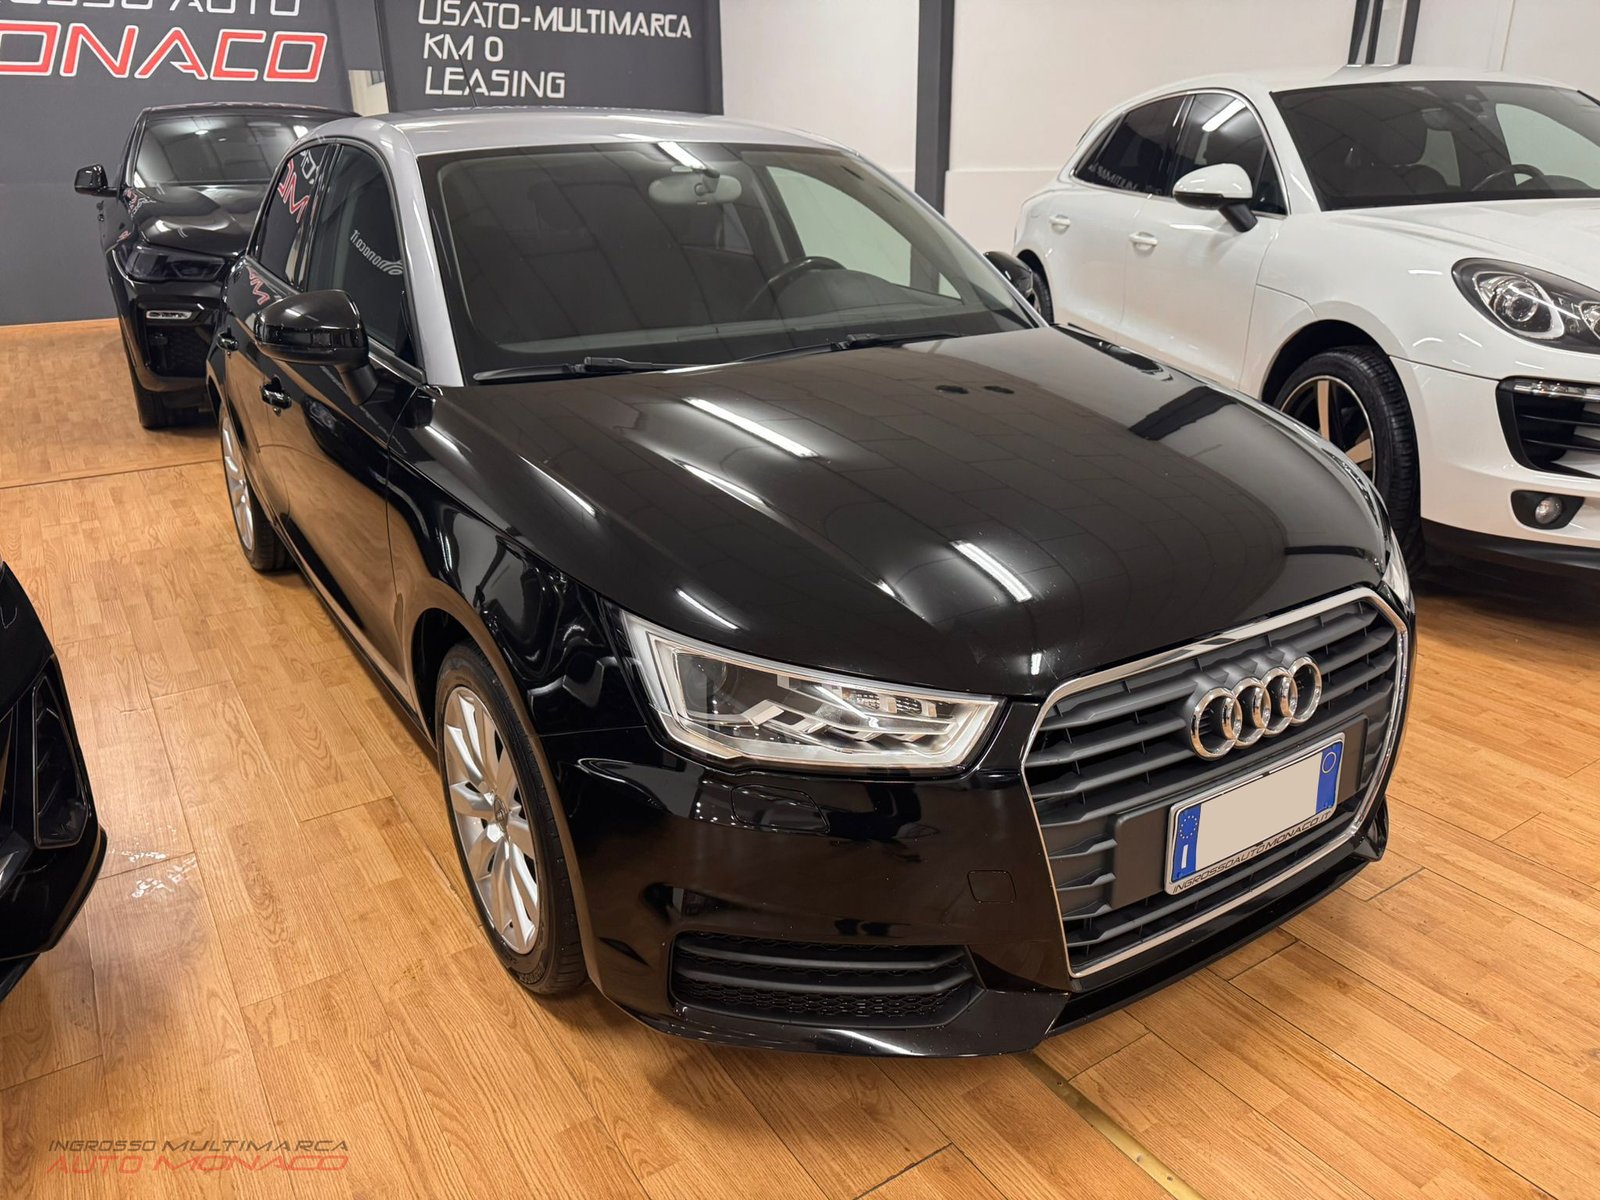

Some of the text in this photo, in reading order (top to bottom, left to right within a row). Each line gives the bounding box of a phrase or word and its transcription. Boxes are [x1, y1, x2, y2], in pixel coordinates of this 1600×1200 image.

[418, 0, 692, 39] USATO-MULTIMARCA
[423, 33, 474, 60] KM
[425, 66, 566, 99] LEASING
[1172, 810, 1331, 894] INGROSSOAUTOMONACO.IT
